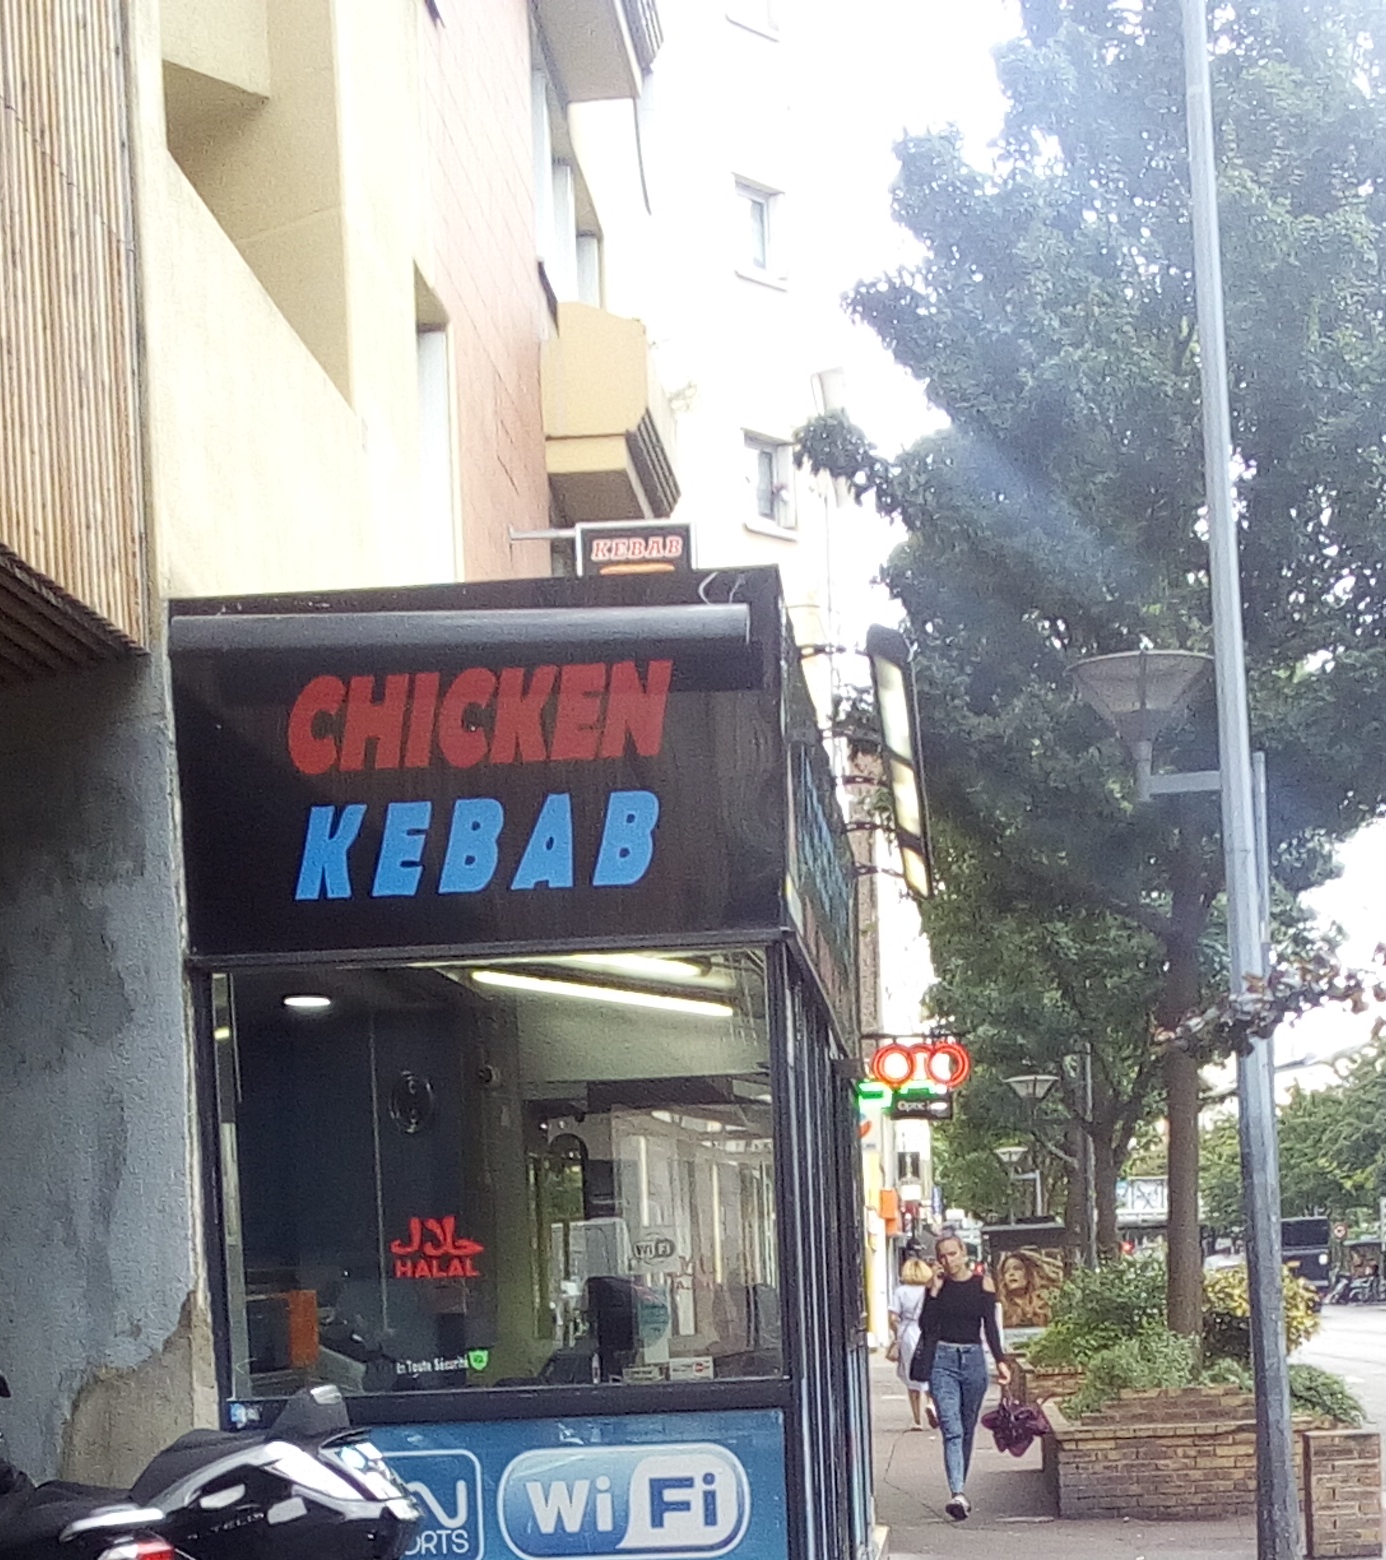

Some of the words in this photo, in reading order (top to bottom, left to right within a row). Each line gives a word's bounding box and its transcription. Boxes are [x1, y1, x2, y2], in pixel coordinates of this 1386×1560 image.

[591, 535, 682, 561] KEBAB
[288, 659, 673, 775] CHICKEN
[295, 788, 660, 901] KEBAB
[395, 1259, 481, 1278] HALAL
